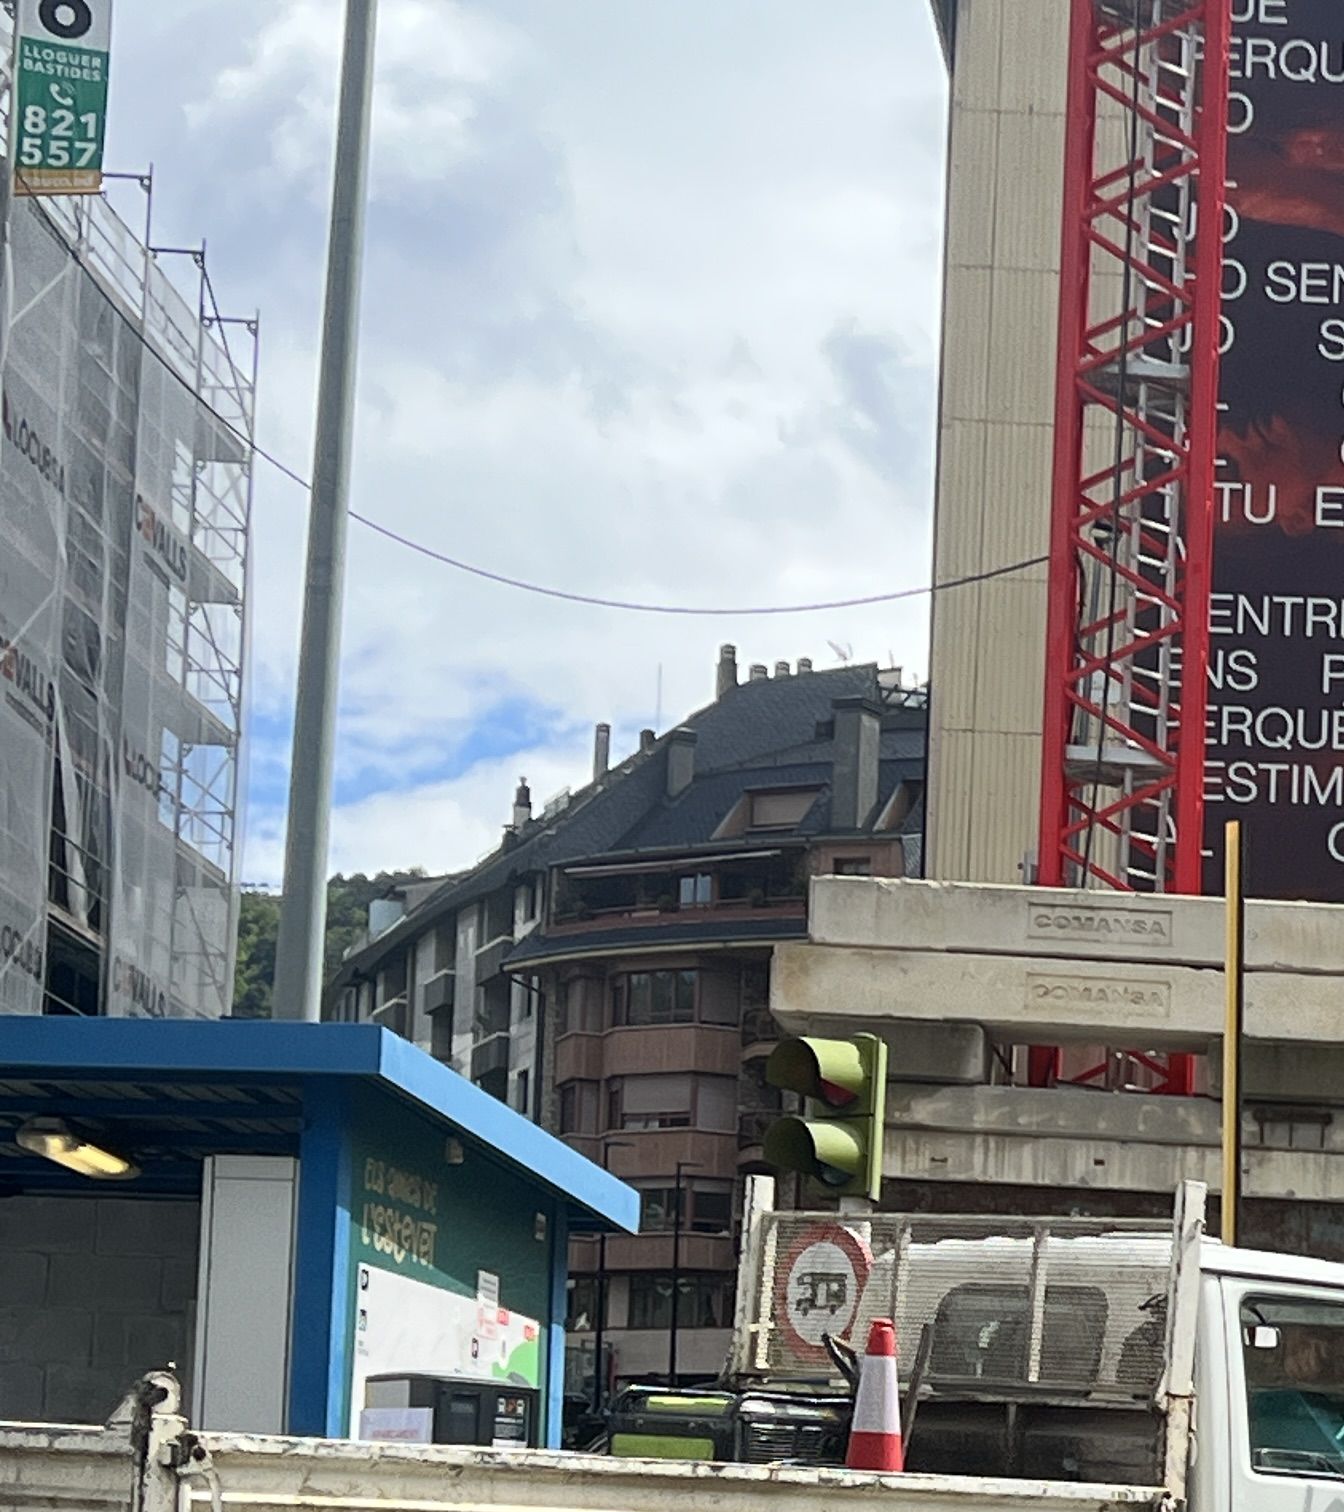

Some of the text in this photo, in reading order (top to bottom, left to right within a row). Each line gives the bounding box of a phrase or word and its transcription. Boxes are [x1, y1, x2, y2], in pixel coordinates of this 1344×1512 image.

[24, 44, 102, 69] LLOGUER
[23, 57, 102, 83] BASTIDES
[24, 104, 98, 139] 821
[20, 137, 98, 167] 557
[1034, 913, 1167, 937] COMANSA
